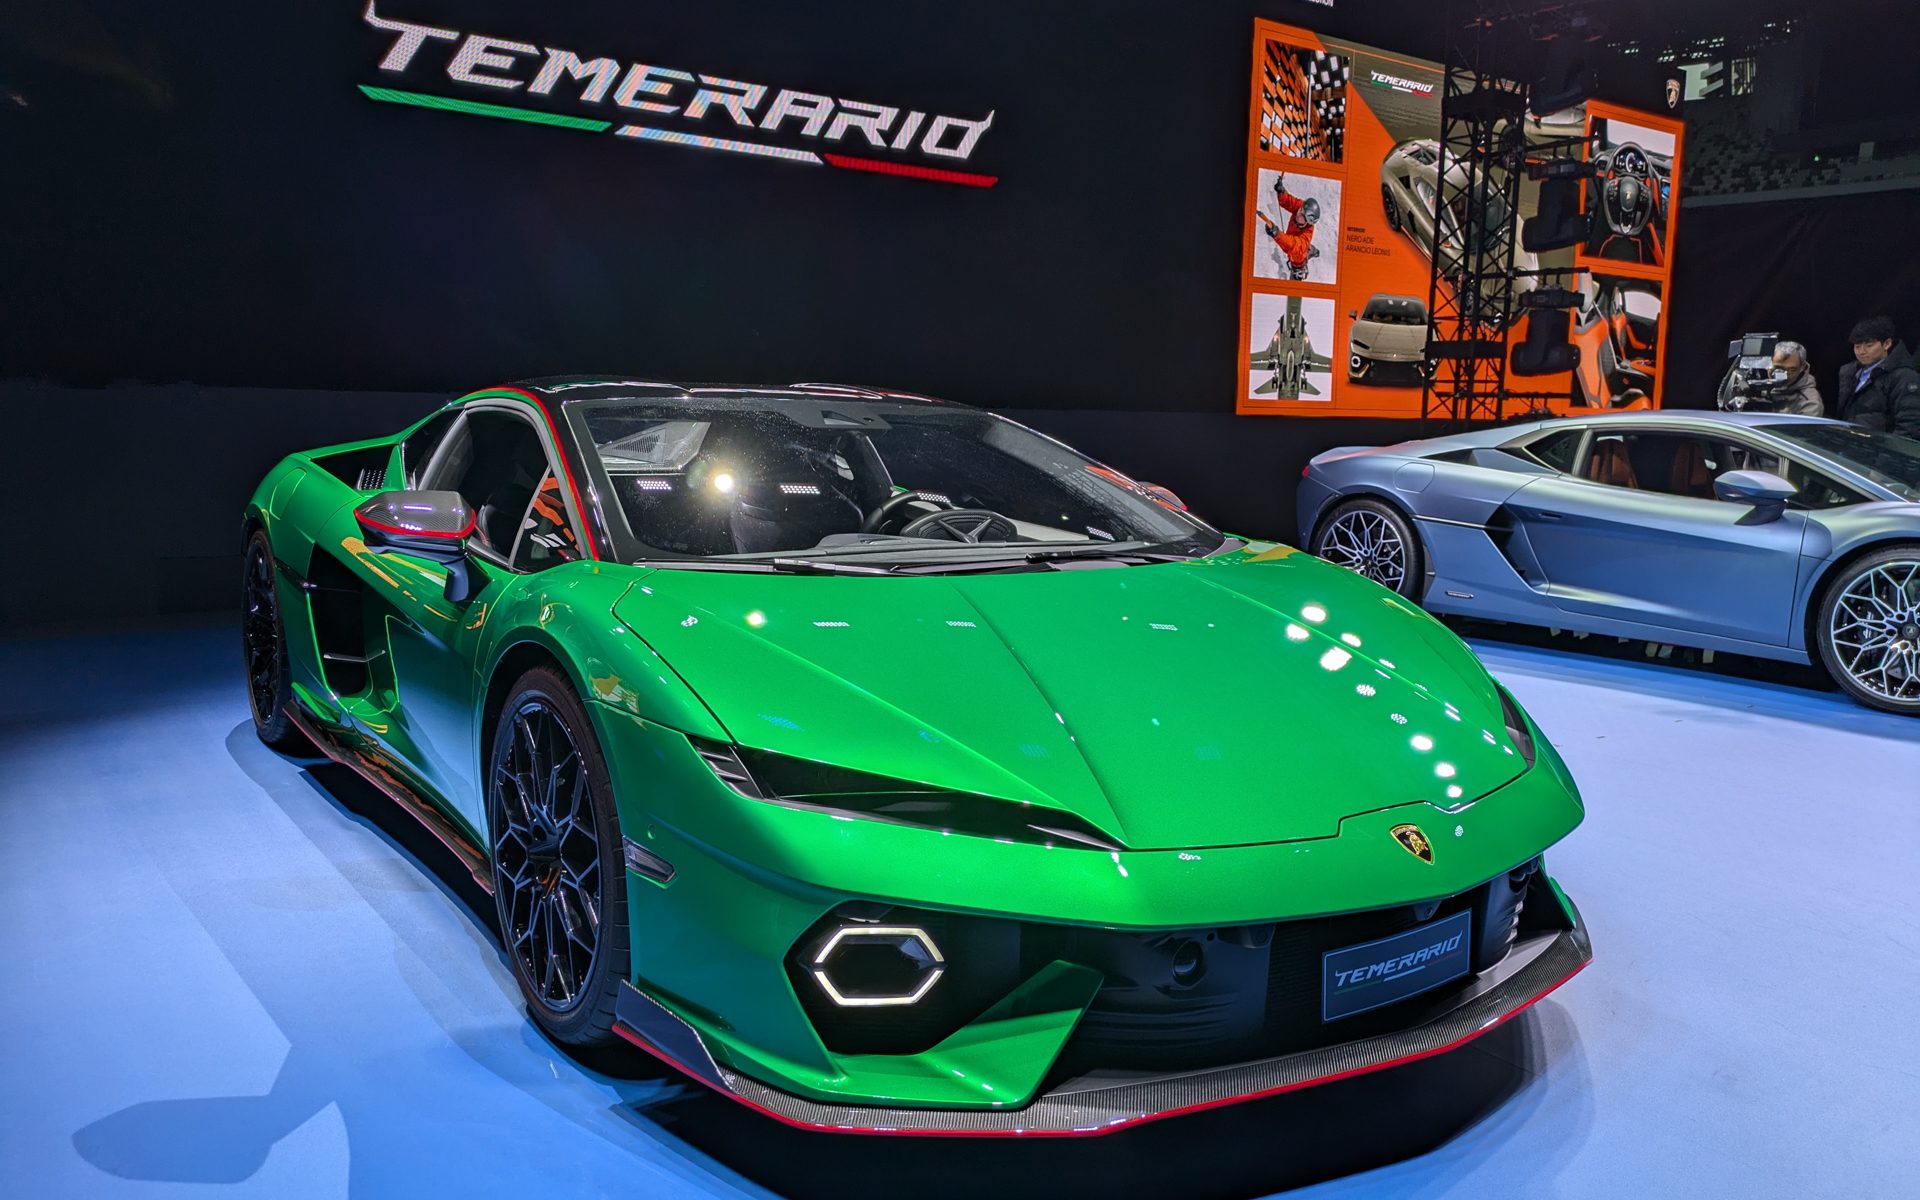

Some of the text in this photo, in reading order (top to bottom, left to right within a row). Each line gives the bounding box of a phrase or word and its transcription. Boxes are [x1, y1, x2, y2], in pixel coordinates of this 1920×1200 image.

[364, 0, 995, 159] TEMERARIO
[1371, 69, 1434, 93] TEMERARIO
[1345, 244, 1371, 254] ARANCIO
[1346, 234, 1375, 245] NERO ADE
[1335, 930, 1463, 987] TEMERARIO
